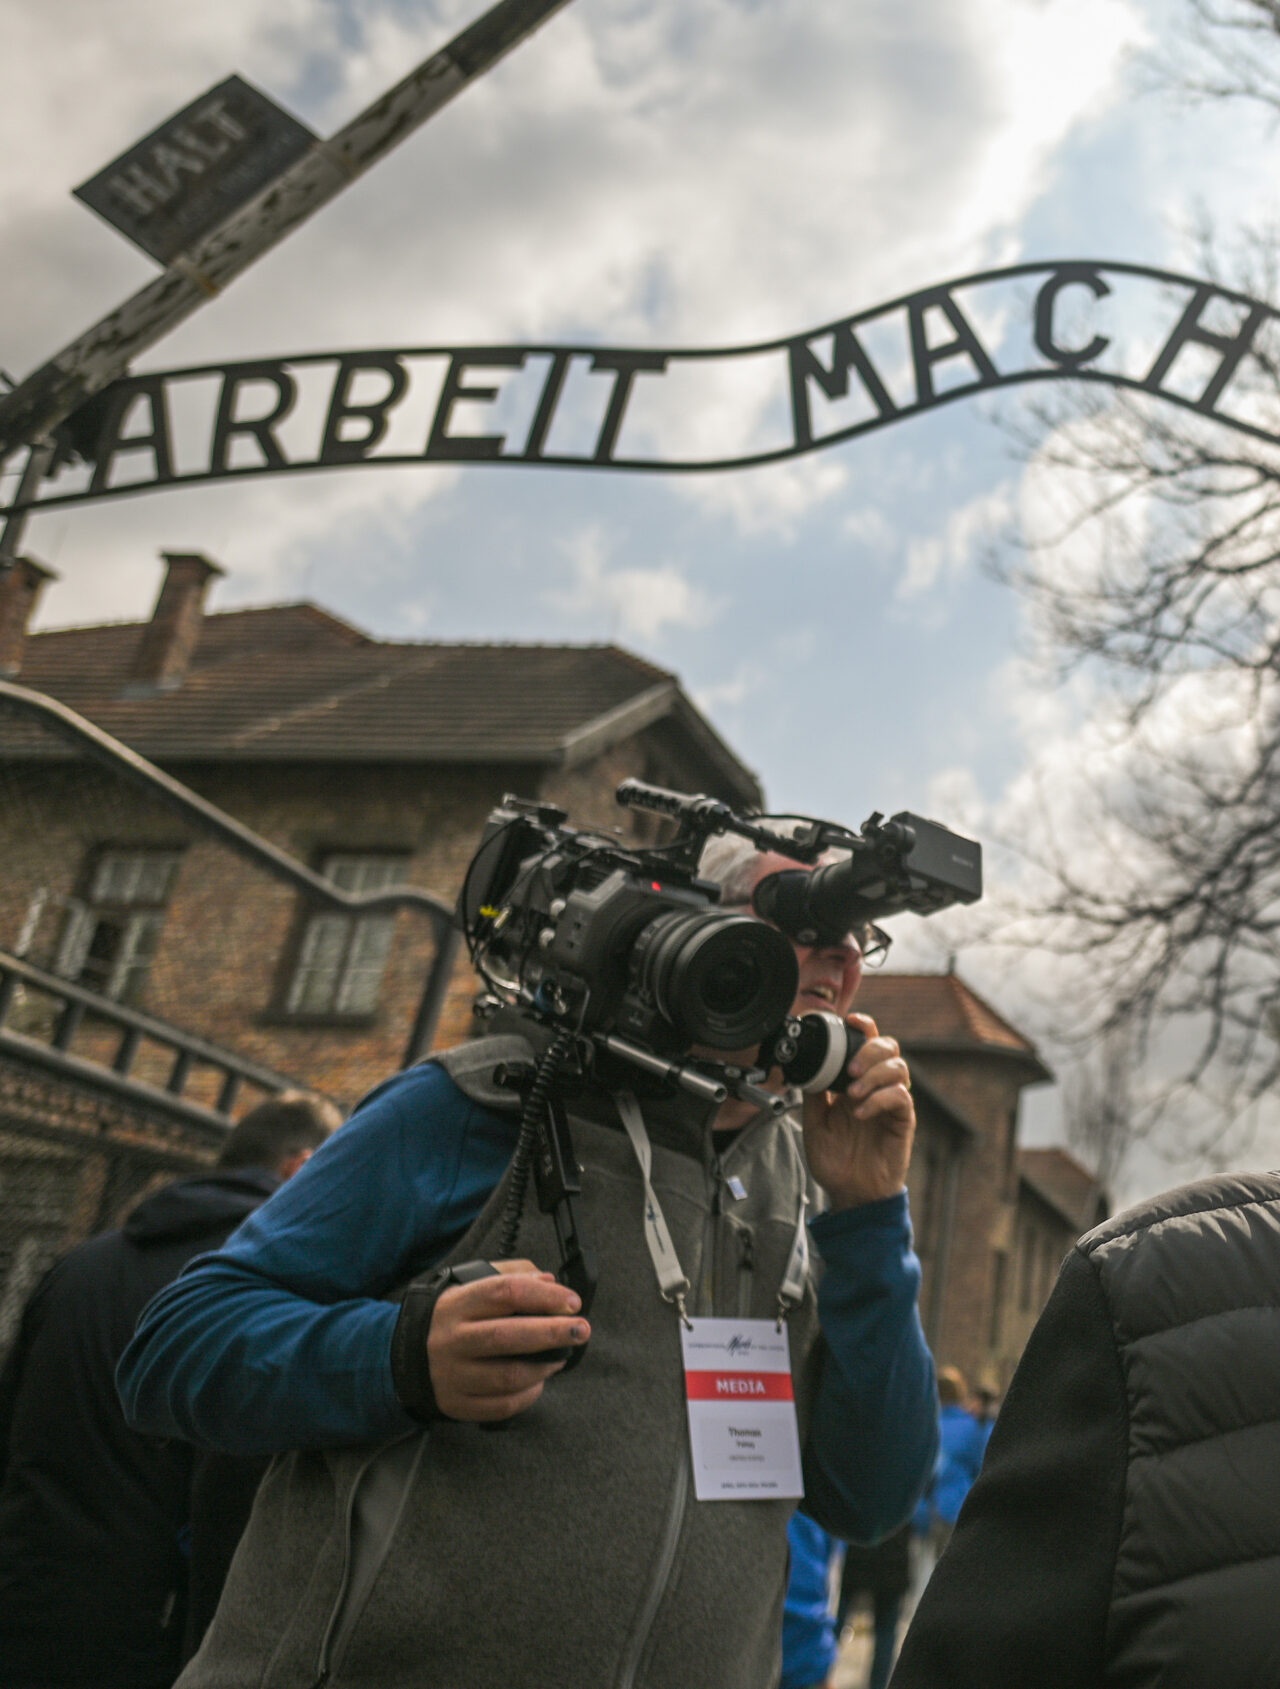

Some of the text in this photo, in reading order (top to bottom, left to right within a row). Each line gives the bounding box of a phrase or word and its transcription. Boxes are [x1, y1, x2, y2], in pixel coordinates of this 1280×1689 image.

[108, 101, 245, 215] HALT
[90, 348, 668, 492] ARBEIT
[716, 1378, 766, 1395] MEDIA
